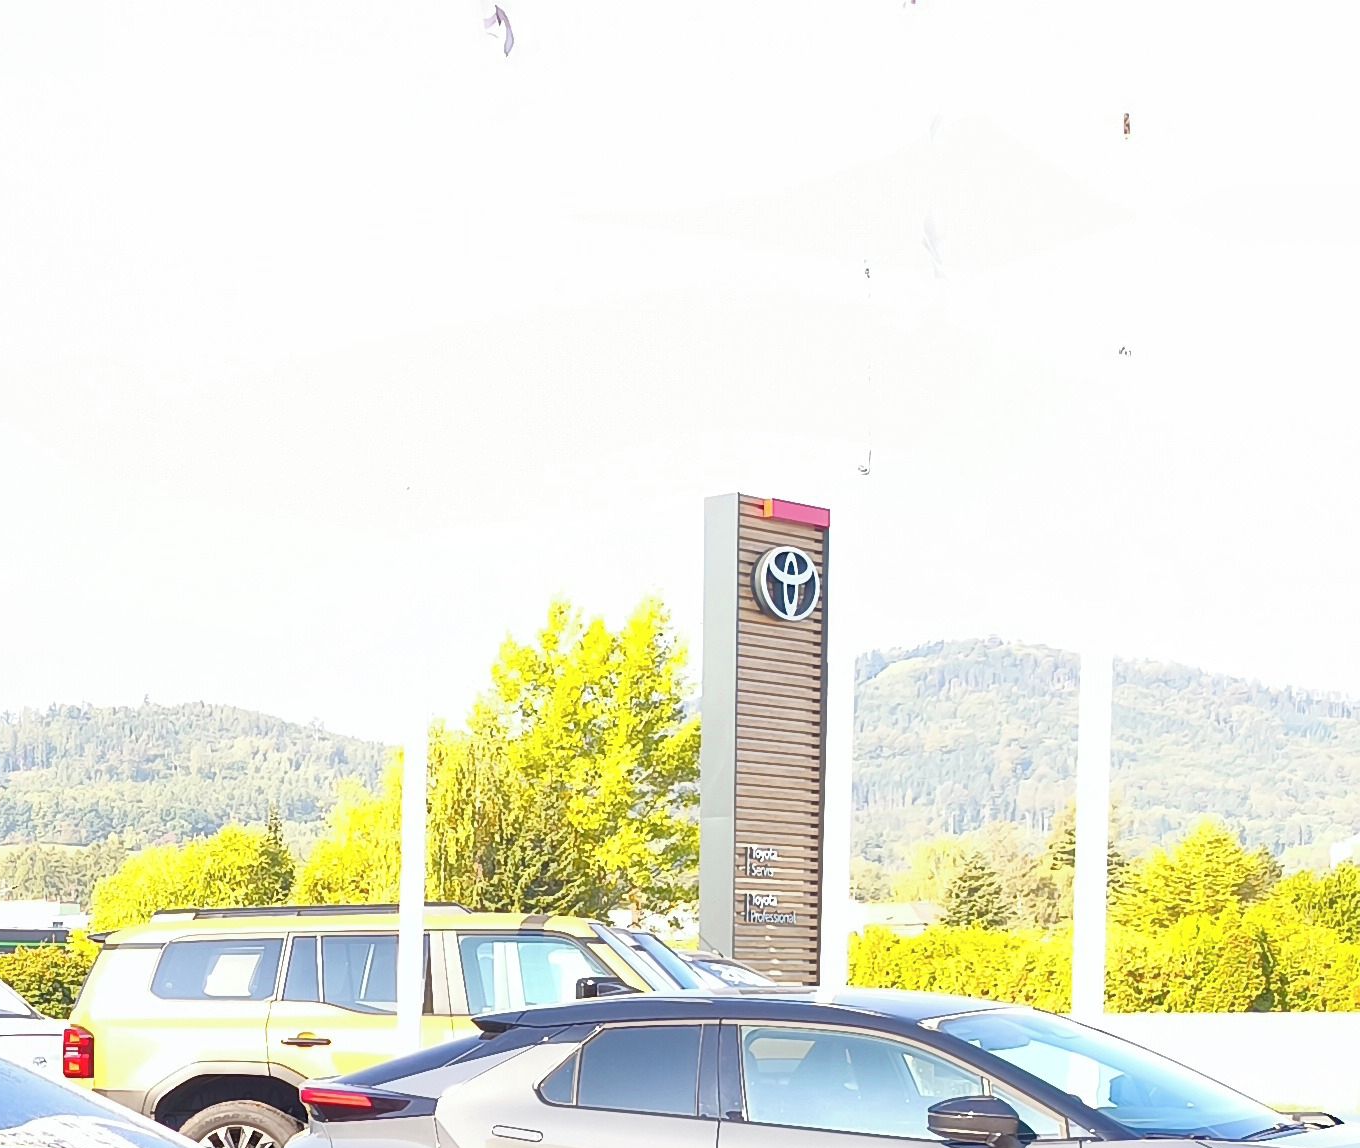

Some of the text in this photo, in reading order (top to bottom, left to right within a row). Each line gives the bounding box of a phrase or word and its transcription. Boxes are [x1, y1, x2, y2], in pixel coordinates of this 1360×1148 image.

[752, 846, 778, 862] Toyota
[751, 863, 774, 877] Servis
[752, 893, 778, 909] Toyota
[750, 909, 797, 924] Professional
